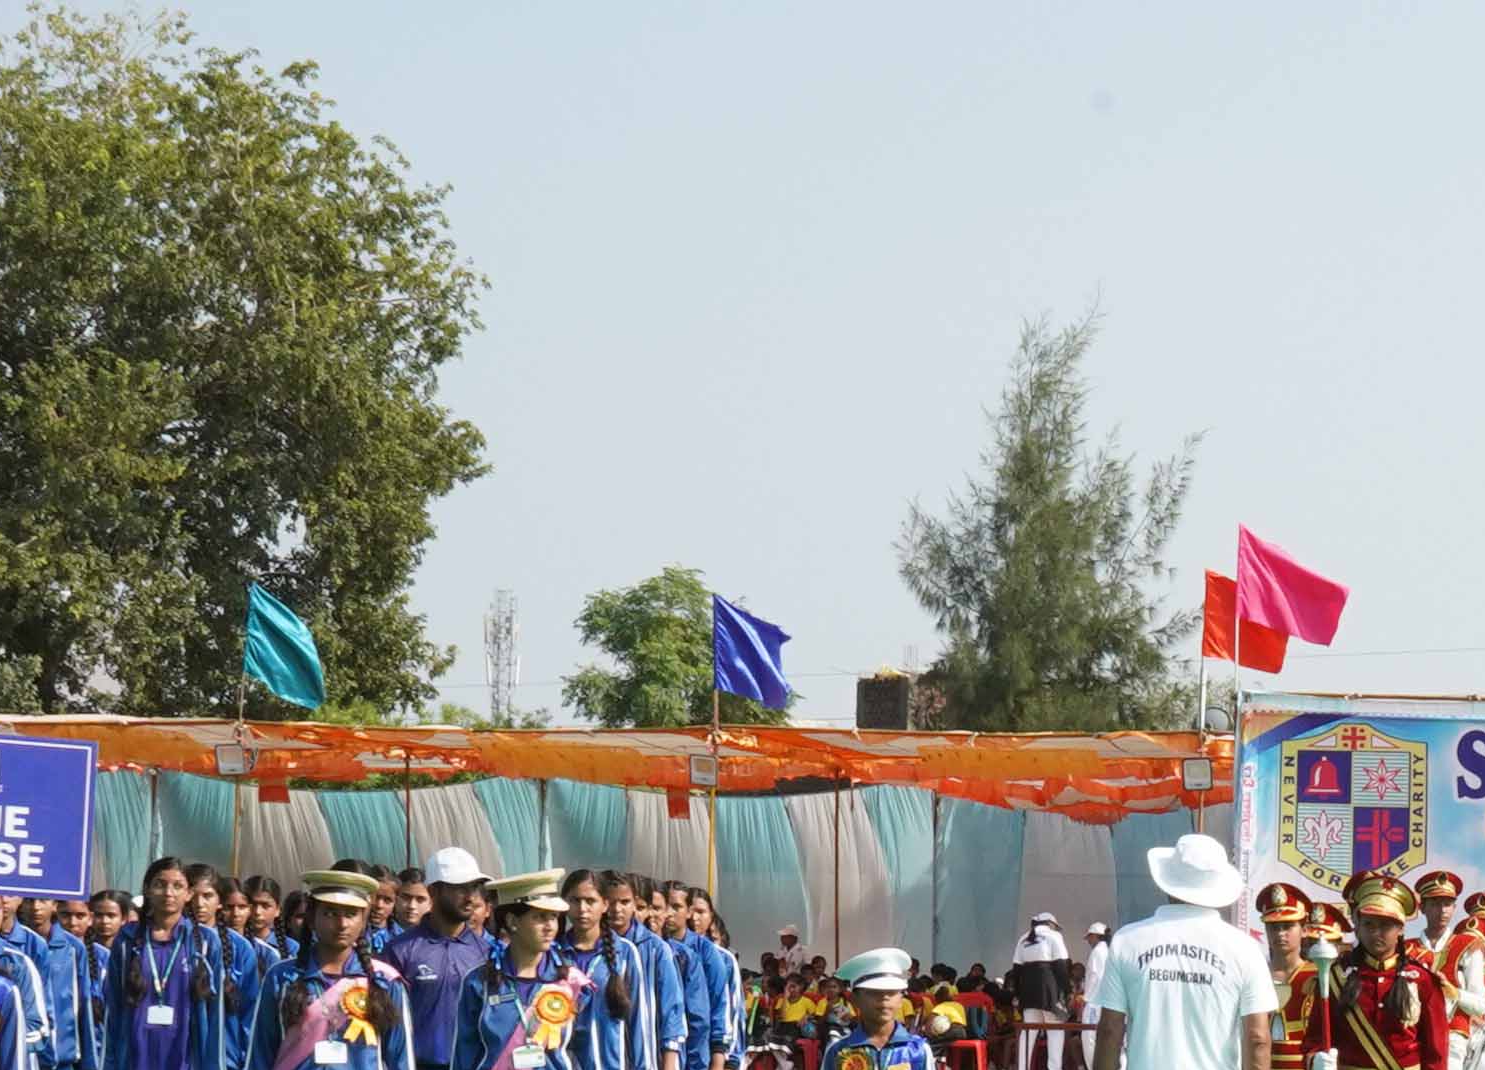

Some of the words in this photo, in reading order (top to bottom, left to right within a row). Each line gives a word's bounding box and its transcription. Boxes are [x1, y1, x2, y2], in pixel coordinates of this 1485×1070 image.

[1282, 755, 1295, 844] NEVER
[1412, 753, 1425, 848] CHARITY
[1138, 943, 1226, 976] THOMASITES
